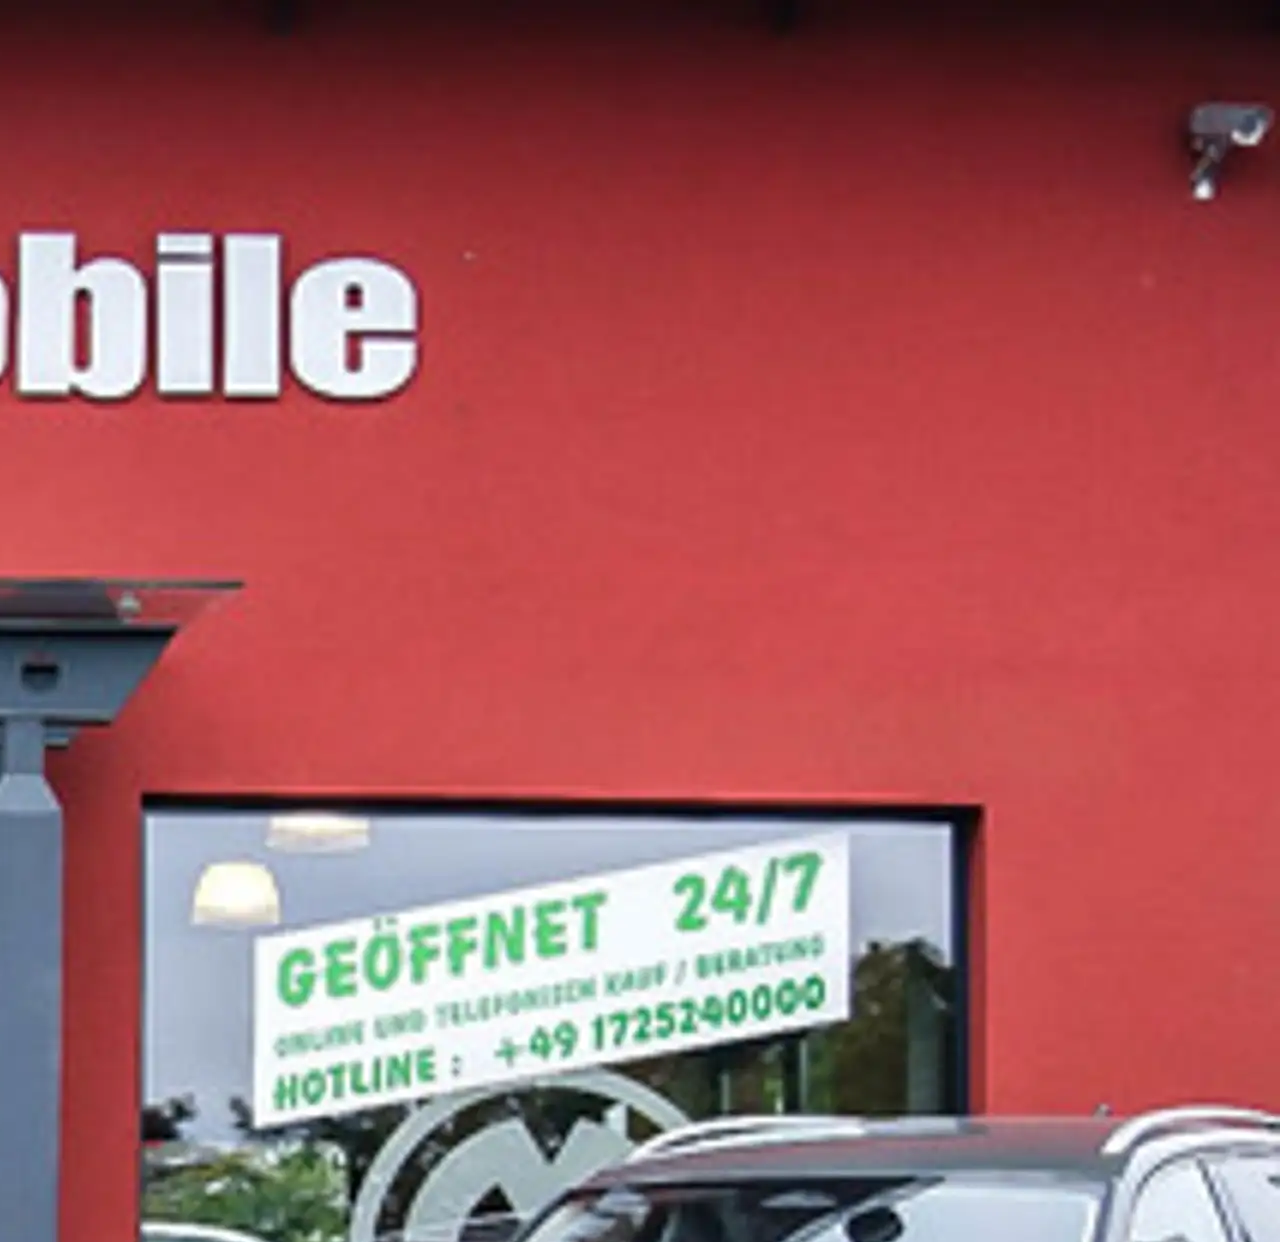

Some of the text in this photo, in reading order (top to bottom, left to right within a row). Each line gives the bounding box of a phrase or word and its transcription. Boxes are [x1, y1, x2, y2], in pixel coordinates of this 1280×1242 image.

[274, 1020, 366, 1059] ONLINE
[373, 1009, 427, 1042] UND
[433, 977, 598, 1029] TELEFONISCH
[603, 964, 668, 998] KAUF
[696, 934, 825, 980] BERATUNG
[277, 851, 823, 1007] GEÖFFNET 24/7
[274, 1047, 436, 1111] HOTLINE
[493, 1026, 579, 1066] +49
[591, 973, 827, 1049] 1725240000
